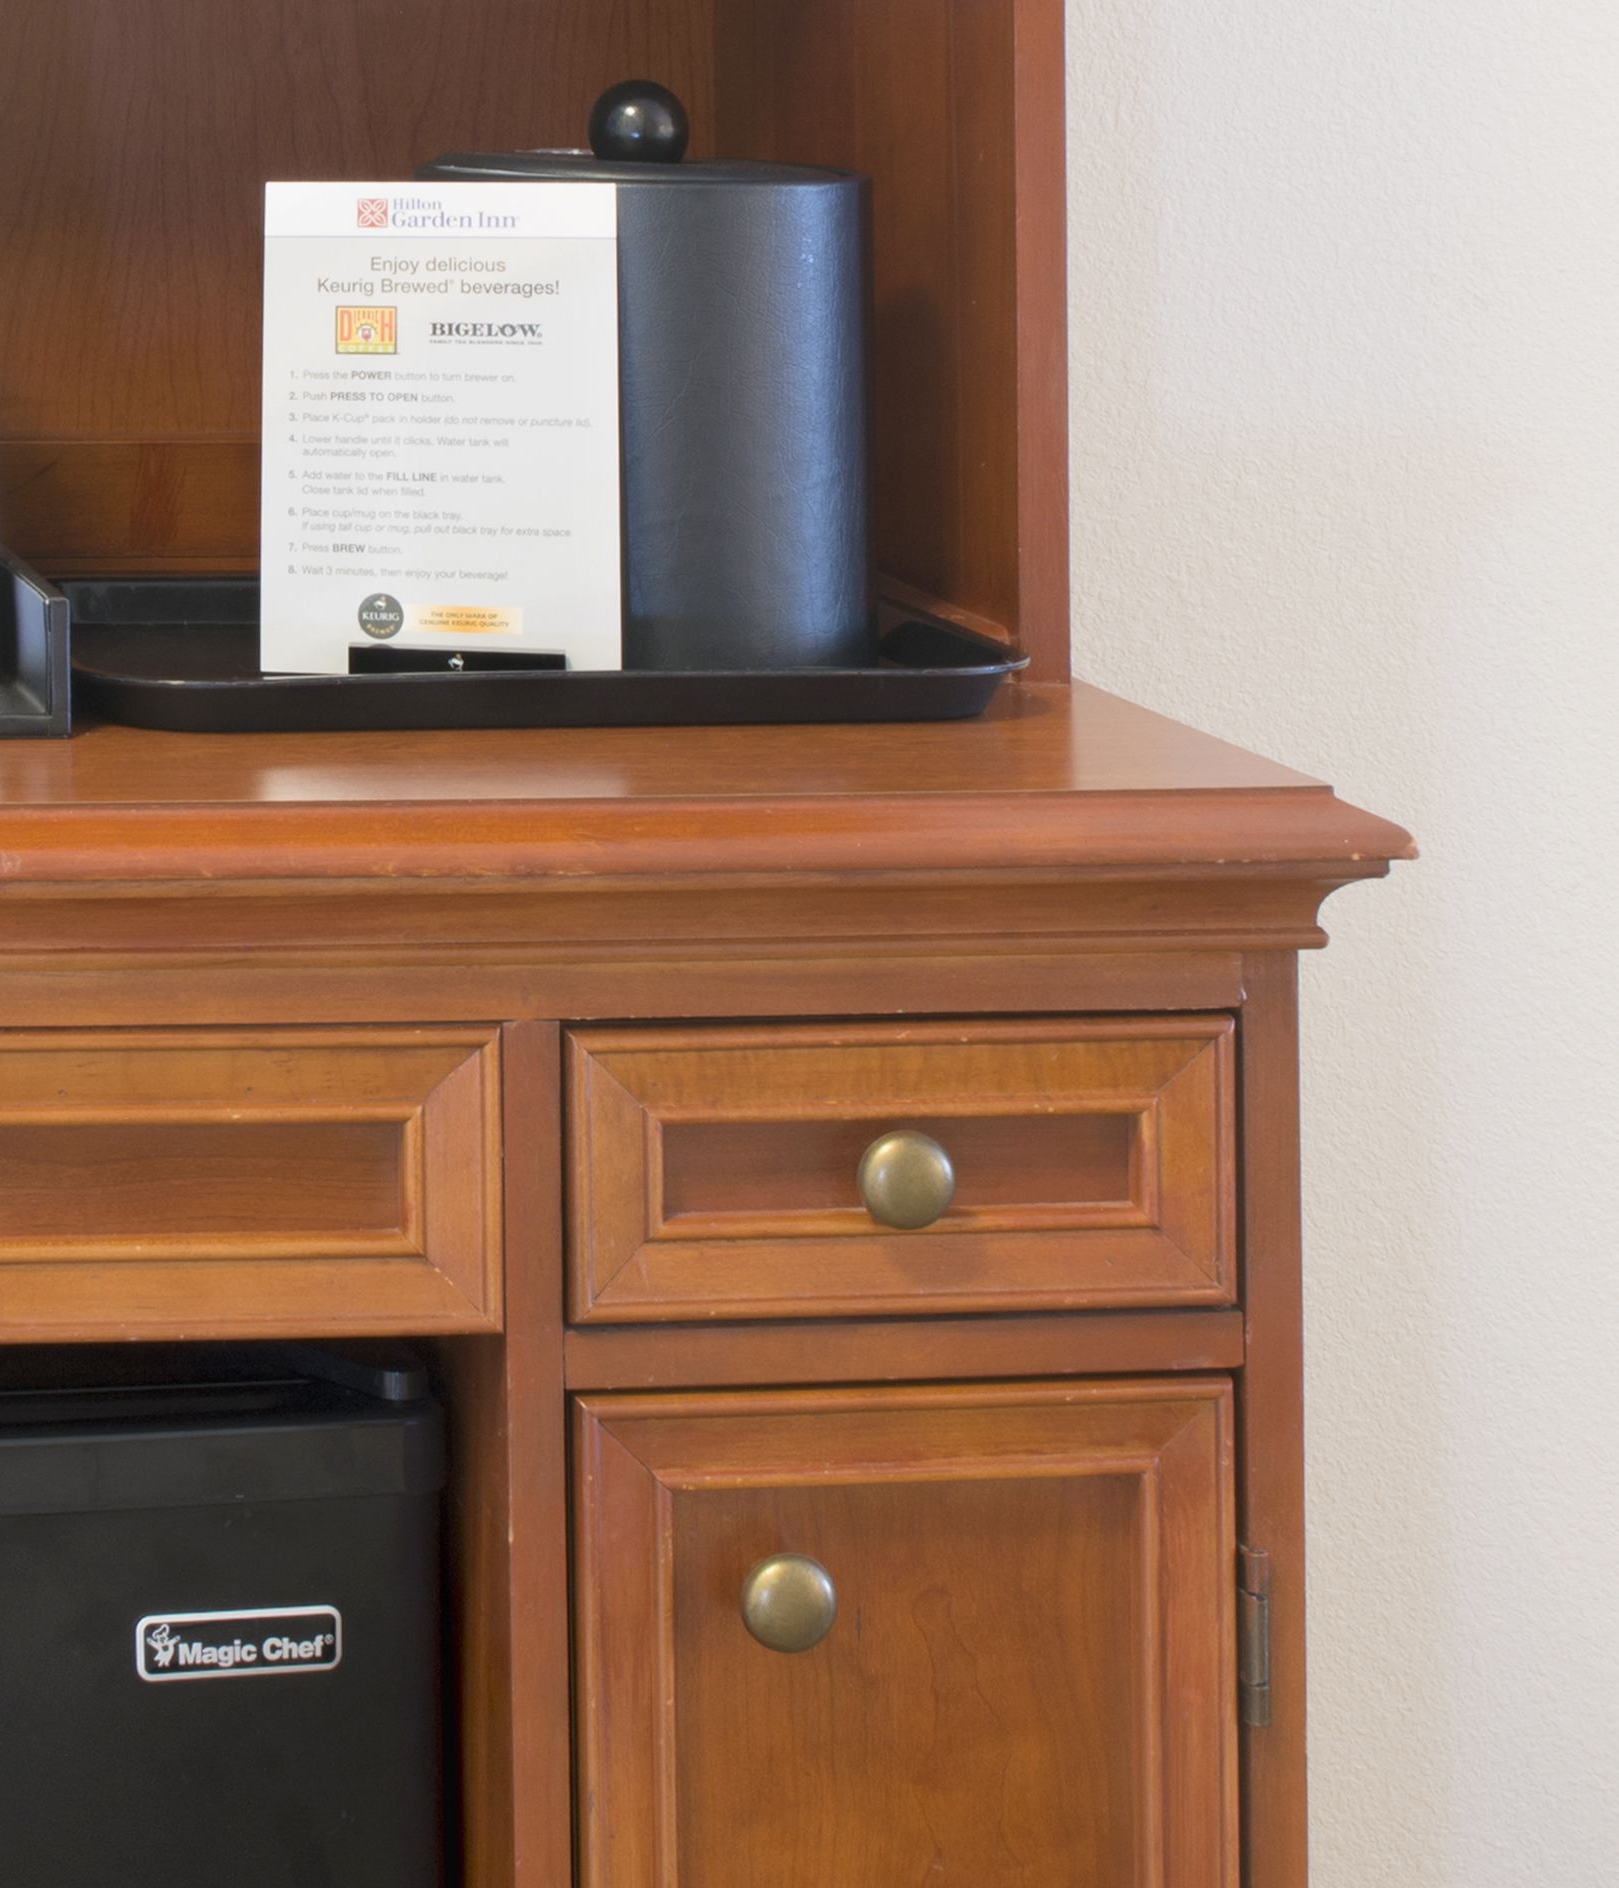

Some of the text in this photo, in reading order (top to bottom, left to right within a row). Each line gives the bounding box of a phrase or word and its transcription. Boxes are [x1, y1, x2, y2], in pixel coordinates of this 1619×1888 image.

[392, 198, 443, 211] Hilton
[391, 211, 516, 229] Garden Inn
[370, 256, 506, 275] Enjoy delicious
[317, 278, 375, 296] Keurig
[460, 280, 560, 297] beverages!
[290, 370, 298, 380] 1.
[302, 370, 330, 380] Press
[333, 370, 349, 380] the
[350, 370, 392, 381] POWER
[394, 371, 427, 381] button
[442, 372, 462, 382] turn
[464, 372, 498, 383] brewer
[288, 391, 298, 401] 2.
[302, 391, 327, 401] Push
[330, 391, 366, 401] PRESS
[369, 392, 385, 402] TO
[387, 392, 419, 402] OPEN
[288, 412, 298, 422] 3.
[302, 413, 330, 422] Place
[372, 415, 396, 425] pack
[399, 415, 408, 424] in
[410, 415, 442, 424] holder
[461, 416, 478, 425] not
[479, 417, 516, 426] remove
[517, 418, 529, 426] or
[530, 417, 573, 427] puncture
[288, 433, 298, 443] 4.
[302, 434, 332, 444] Lower
[334, 434, 368, 444] handle
[371, 435, 392, 445] until
[437, 436, 466, 446] Water
[468, 437, 490, 447] tank
[493, 437, 509, 447] will
[302, 447, 366, 459] automatically
[288, 470, 298, 480] 5.
[301, 470, 322, 480] Add
[325, 471, 352, 481] water
[355, 472, 366, 481] to
[367, 472, 384, 481] the
[386, 471, 409, 482] FILL
[412, 472, 438, 482] LINE
[440, 472, 449, 482] in
[451, 474, 479, 484] water
[302, 484, 330, 495] Close
[332, 485, 354, 495] tank
[356, 485, 369, 496] lid
[371, 486, 398, 496] when
[288, 507, 298, 516] 6.
[302, 507, 330, 517] Place
[332, 508, 376, 520] cup/mug
[378, 510, 392, 518] on
[394, 509, 410, 519] the
[412, 510, 439, 520] black
[309, 521, 336, 533] using
[338, 522, 352, 532] tall
[353, 524, 373, 534] cup
[374, 524, 386, 533] or
[413, 524, 432, 535] pull
[433, 525, 450, 534] out
[451, 525, 477, 535] black
[479, 526, 499, 537] tray
[500, 526, 515, 536] for
[516, 526, 540, 536] extra
[288, 542, 298, 552] 7.
[302, 543, 330, 553] Press
[332, 543, 366, 553] BREW
[288, 565, 509, 582] 8. Wait 3 minutes, then enjoy your beverage!
[362, 611, 400, 622] KEURIG
[178, 1639, 257, 1668] Magic
